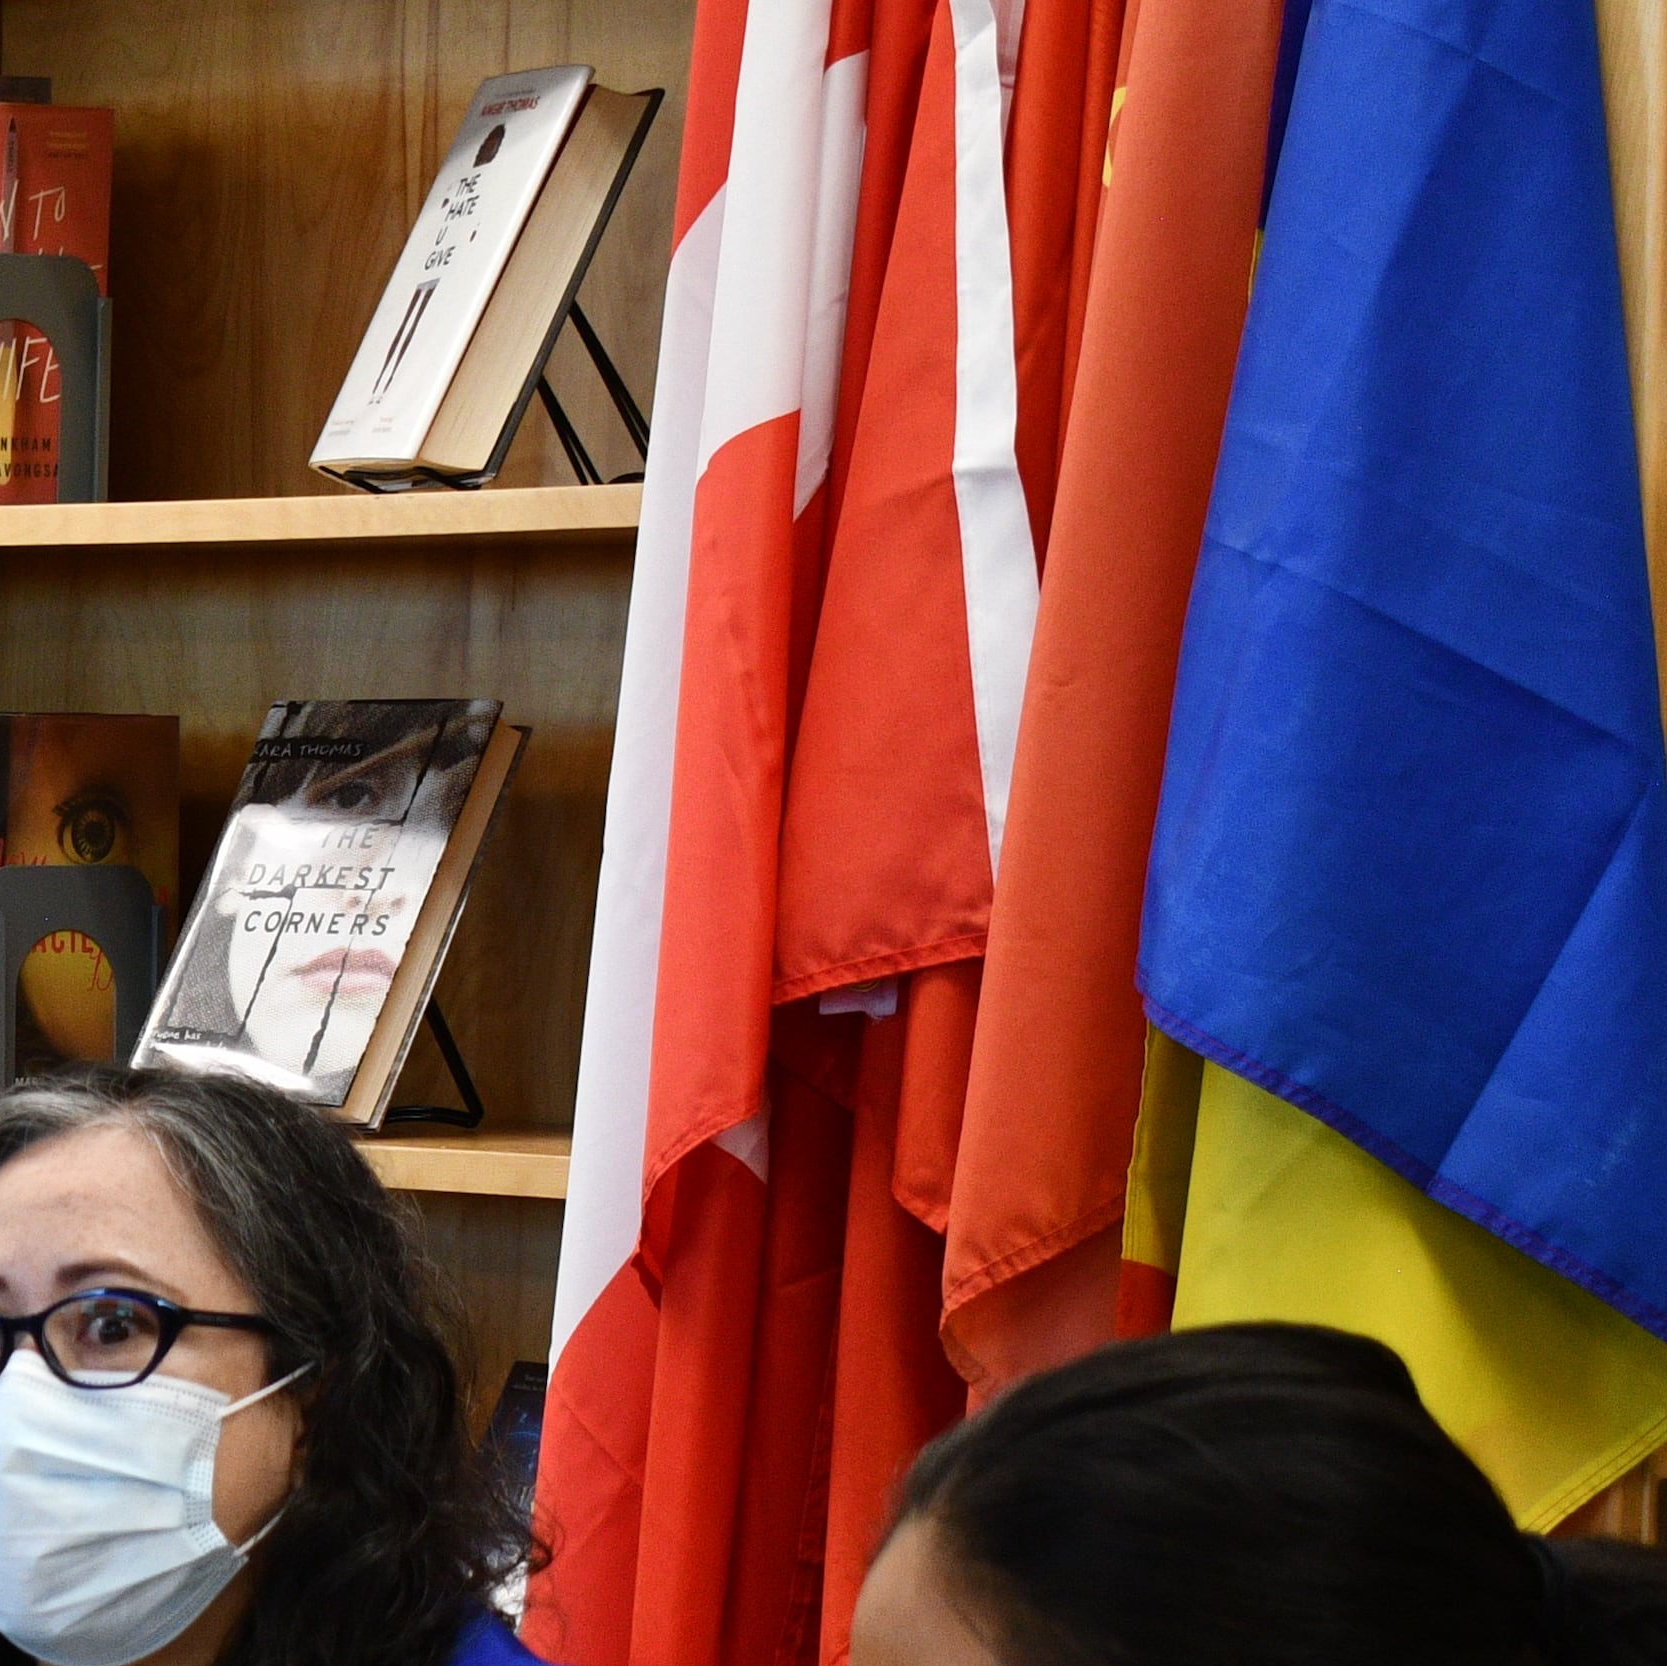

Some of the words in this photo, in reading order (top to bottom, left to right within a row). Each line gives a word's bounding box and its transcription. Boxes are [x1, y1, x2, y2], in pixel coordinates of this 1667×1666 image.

[480, 99, 506, 117] ANGIE
[505, 95, 541, 113] THOMAS
[455, 173, 482, 199] THE
[28, 185, 66, 242] TO
[445, 194, 480, 223] HATE
[434, 226, 450, 248] U
[423, 246, 456, 271] GIVE
[299, 742, 364, 759] THOMAS
[320, 826, 380, 850] THE
[247, 862, 396, 891] DARKEST
[243, 909, 391, 936] CORNERS
